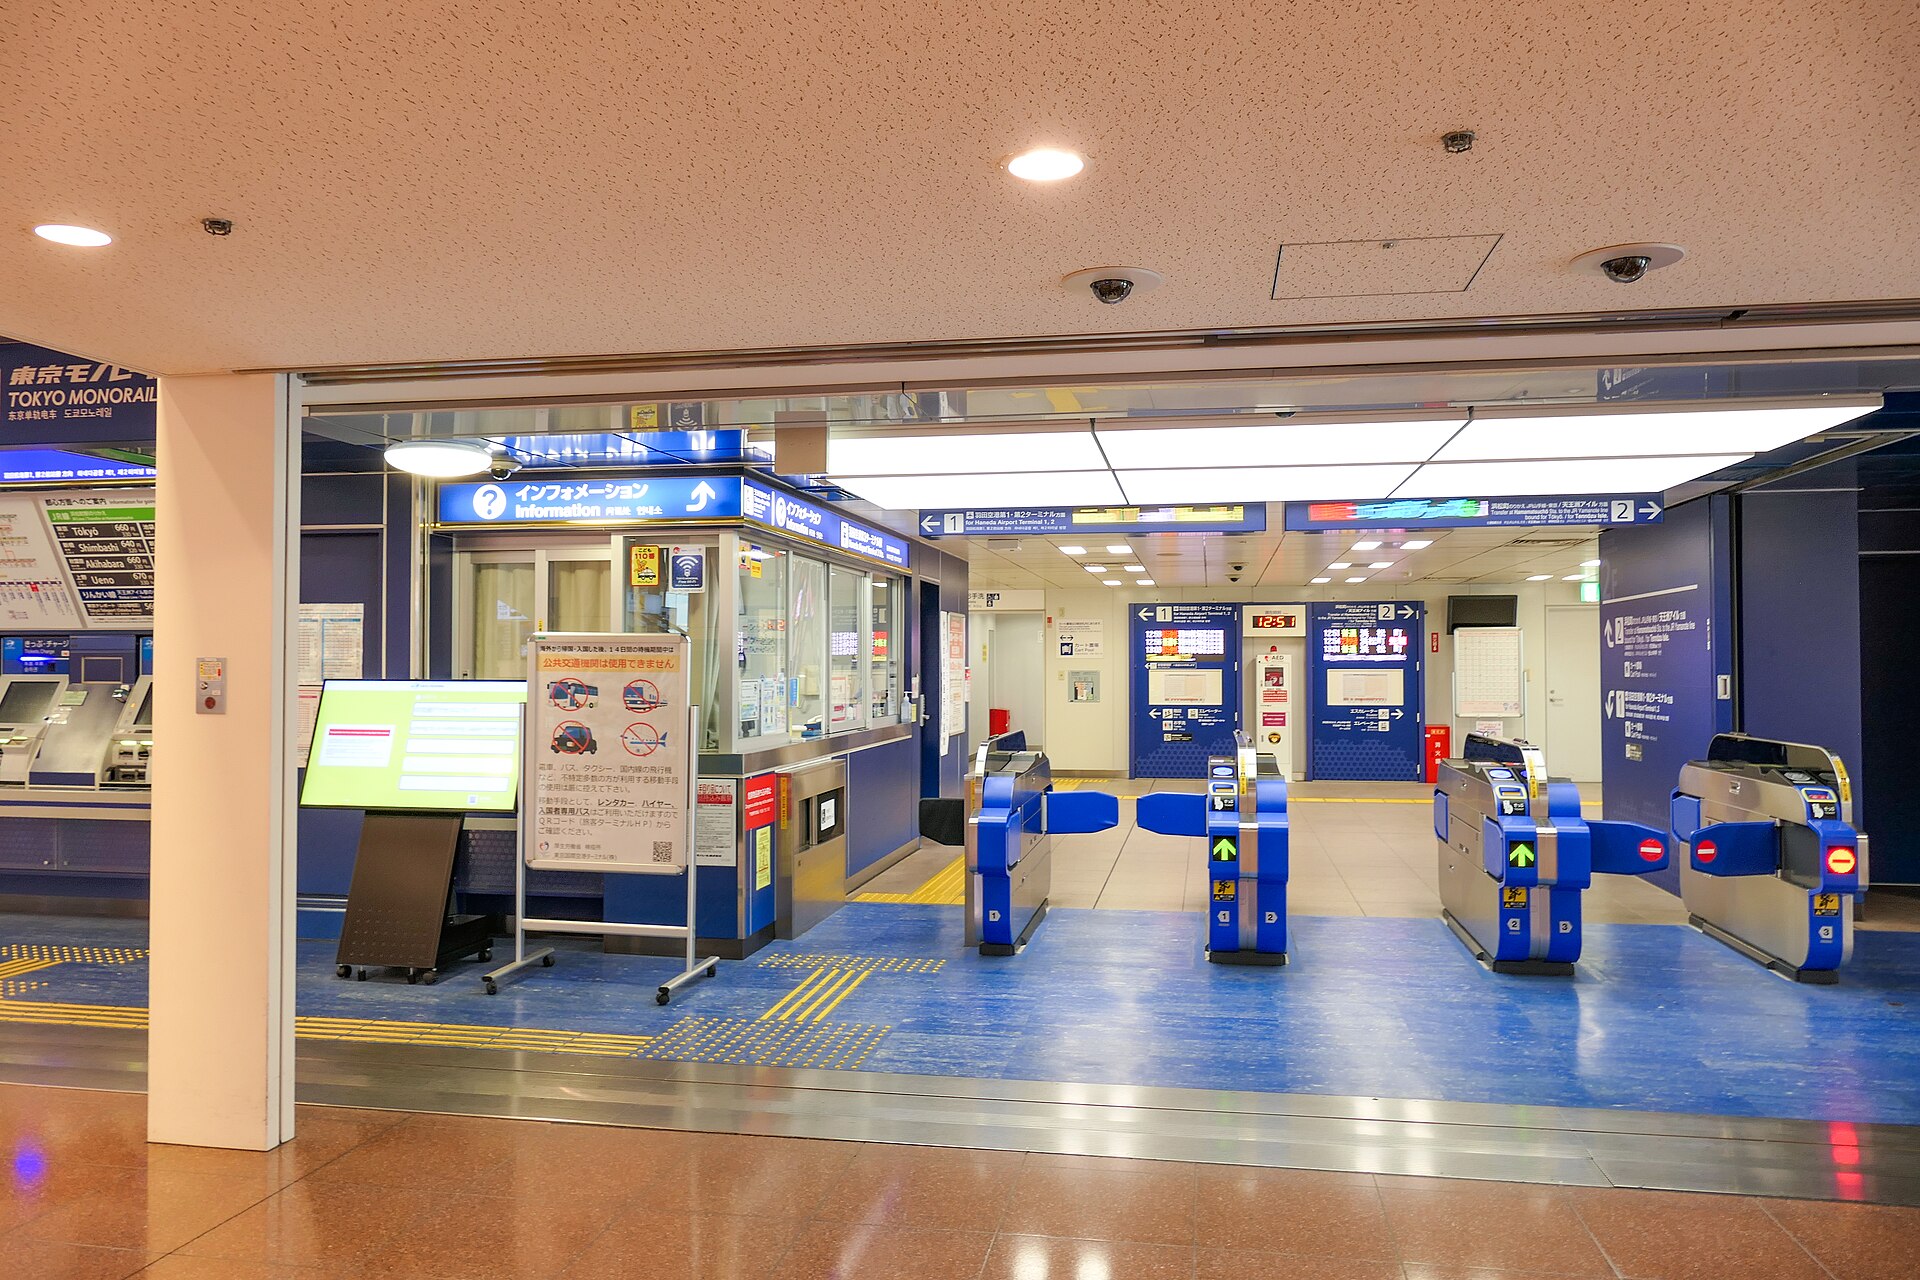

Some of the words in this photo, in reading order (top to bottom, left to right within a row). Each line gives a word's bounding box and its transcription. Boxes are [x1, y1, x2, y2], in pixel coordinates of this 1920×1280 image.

[8, 389, 66, 407] TOKYO
[68, 386, 157, 405] MONORAIL
[8, 409, 57, 420] 东京单轨电车
[63, 407, 112, 418] 도쿄모노레일
[515, 483, 649, 501] インフォメーション
[515, 502, 601, 518] Information
[1617, 502, 1629, 519] 2
[114, 524, 130, 532] 660
[950, 515, 957, 531] 1
[78, 542, 120, 552] Shimbashi
[85, 559, 125, 569] Akihabara
[126, 556, 141, 564] 660
[91, 575, 115, 585] Ueno
[132, 572, 148, 580] 670
[82, 590, 117, 599] りんかい線
[1161, 608, 1167, 620] 1
[1382, 605, 1391, 619] 2
[1258, 616, 1296, 628] 12:51
[24, 640, 70, 648] きっぷ・チャージ
[543, 658, 675, 669] 公共交通機関は使用できません
[991, 912, 998, 920] 1
[1222, 912, 1228, 920] 1
[1266, 912, 1274, 921] 2
[1511, 920, 1518, 928] 2
[1561, 922, 1569, 931] 3
[1822, 928, 1830, 937] 3
